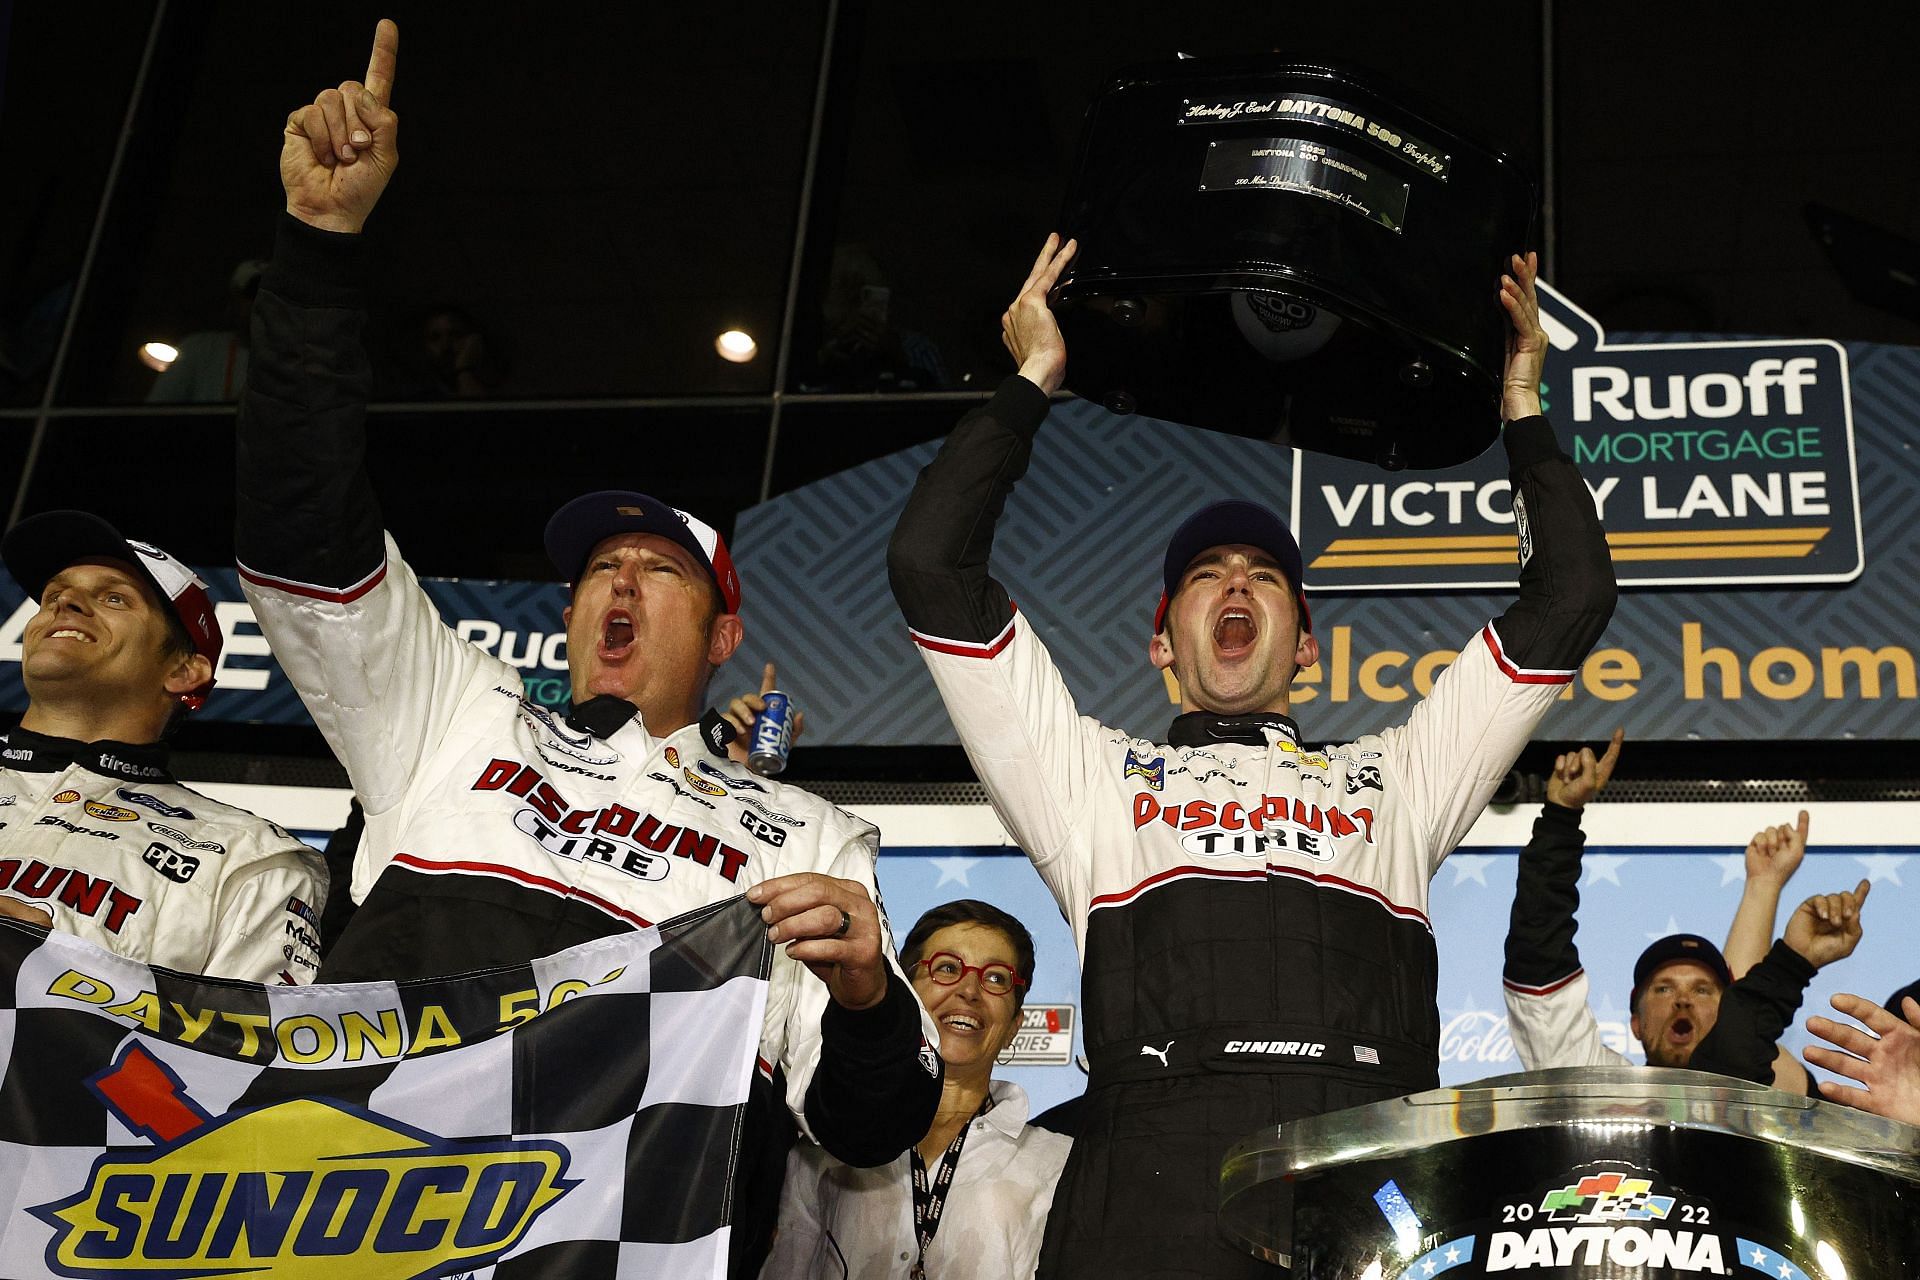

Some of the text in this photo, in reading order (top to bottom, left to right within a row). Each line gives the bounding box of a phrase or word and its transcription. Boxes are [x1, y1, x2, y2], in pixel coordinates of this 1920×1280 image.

[1186, 104, 1231, 119] Harley
[1245, 100, 1276, 114] Earl
[1277, 99, 1365, 130] DAYTONA
[1367, 121, 1401, 148] 500
[1403, 142, 1443, 172] Trophy
[1252, 149, 1295, 158] DAYTONA
[1299, 151, 1319, 162] 500
[1572, 357, 1818, 422] Ruoff
[1575, 428, 1823, 464] MORTGAGE
[1321, 476, 1620, 527] VICTOY
[1643, 471, 1830, 520] LANE
[33, 815, 120, 841] Snap-on
[471, 758, 749, 885] DISCOUNT
[742, 813, 784, 845] PPG
[1133, 792, 1375, 844] DISCOUNT
[146, 846, 197, 879] PPG
[531, 815, 654, 877] TIRE
[1196, 832, 1321, 855] TIRE
[47, 970, 462, 1064] DAYTONA
[1223, 1040, 1326, 1058] CINDRIC
[75, 1161, 547, 1260] SUNOCO
[1502, 1203, 1710, 1225] 20 22
[1486, 1226, 1726, 1275] DAYTONA
